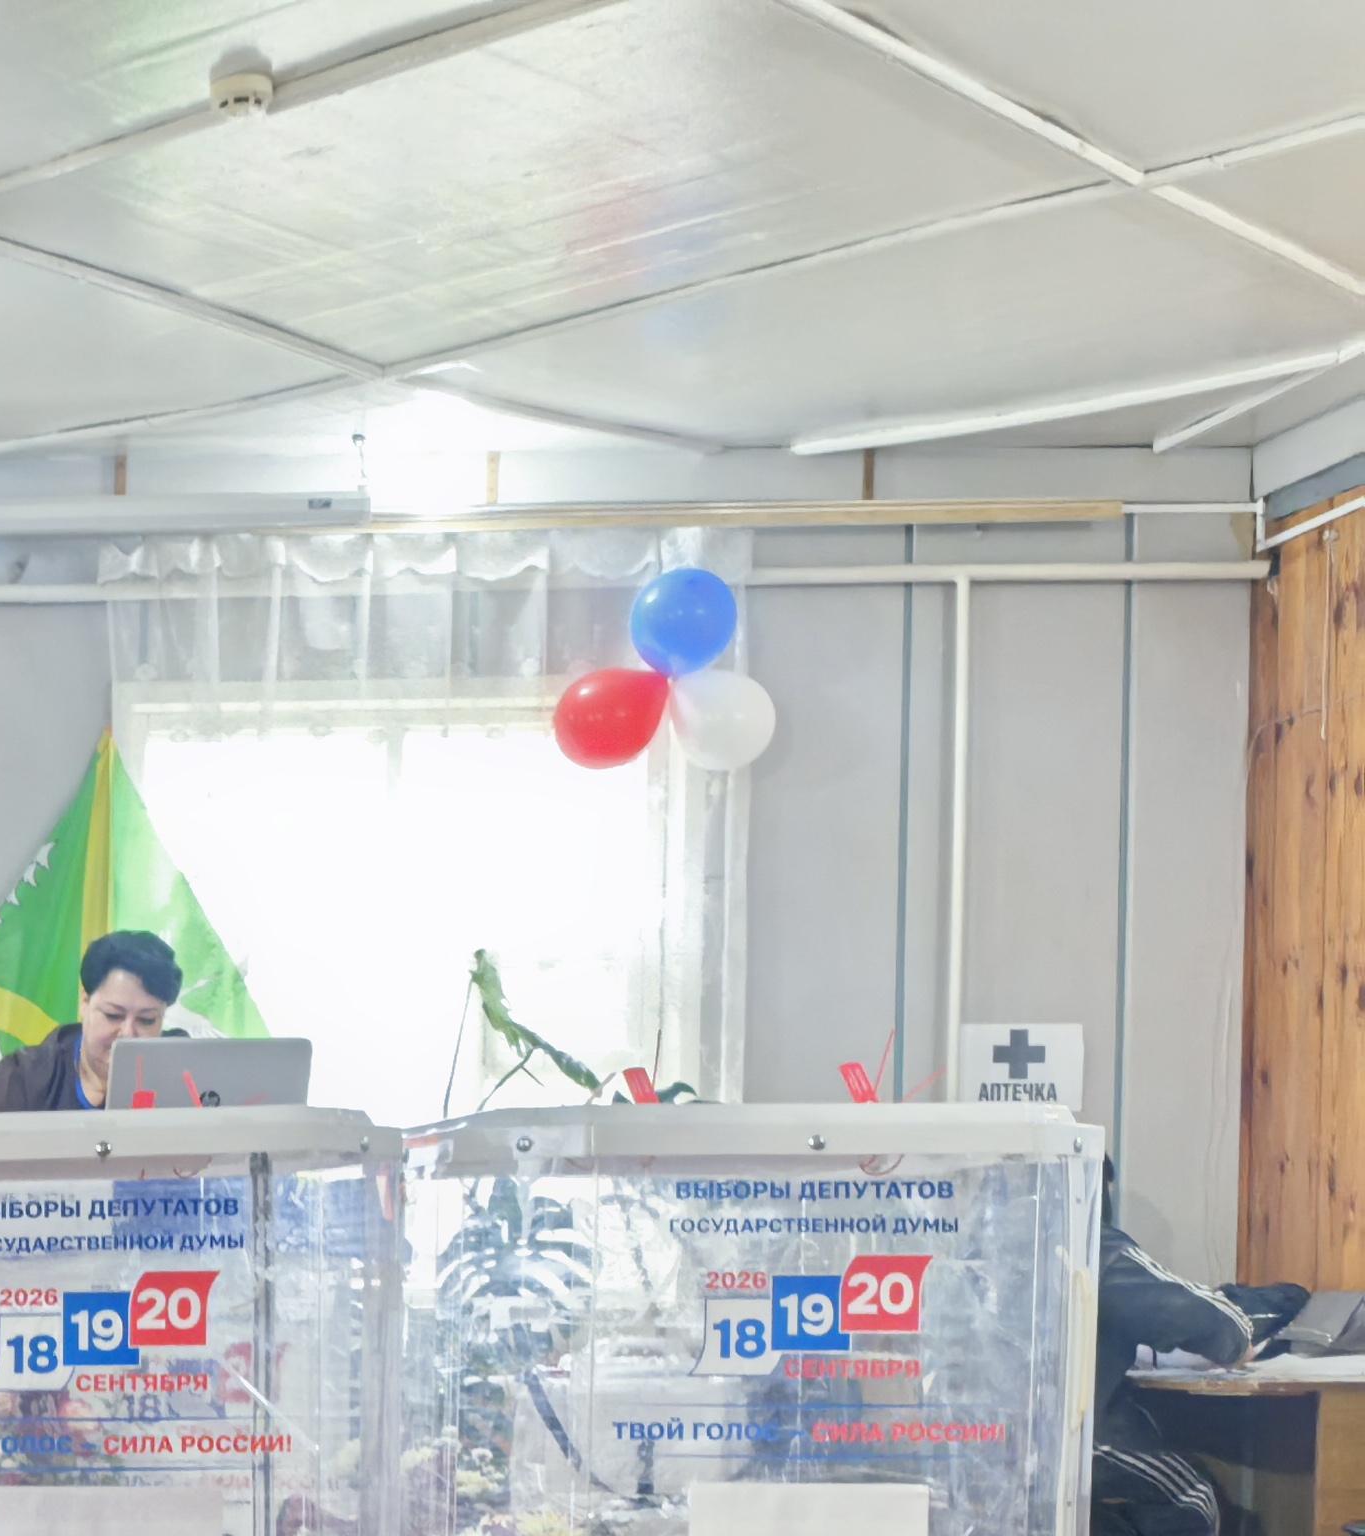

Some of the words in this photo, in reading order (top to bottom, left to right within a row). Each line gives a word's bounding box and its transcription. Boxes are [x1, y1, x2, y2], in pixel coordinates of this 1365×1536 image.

[978, 1082, 1057, 1102] АПТЕЧКА
[675, 1180, 790, 1200] ВЫБОРЫ
[798, 1179, 954, 1202] ДЕПУТАТОВ
[88, 1198, 239, 1220] ДЕПУТАТОВ
[669, 1213, 887, 1235] ГОСУДАРСТВЕННОЙ
[892, 1216, 959, 1235] ДУМЫ
[180, 1234, 245, 1252] ДУМЫ
[705, 1271, 767, 1291] 2026
[0, 1288, 58, 1307] 2026
[713, 1318, 766, 1359] 18
[779, 1293, 834, 1337] 19
[847, 1272, 914, 1315] 20
[6, 1334, 58, 1375] 18
[70, 1309, 124, 1351] 19
[136, 1287, 201, 1331] 20
[784, 1358, 921, 1379] СЕНТЯБРЯ
[76, 1373, 209, 1392] СЕНТЯБРЯ
[612, 1417, 684, 1441] ТВОЙ
[693, 1421, 782, 1441] ГОЛОС
[812, 1421, 883, 1442] СИЛА
[891, 1421, 1005, 1443] РОССИИ!
[103, 1435, 173, 1454] СИЛА
[181, 1434, 292, 1454] РОССИИ!
